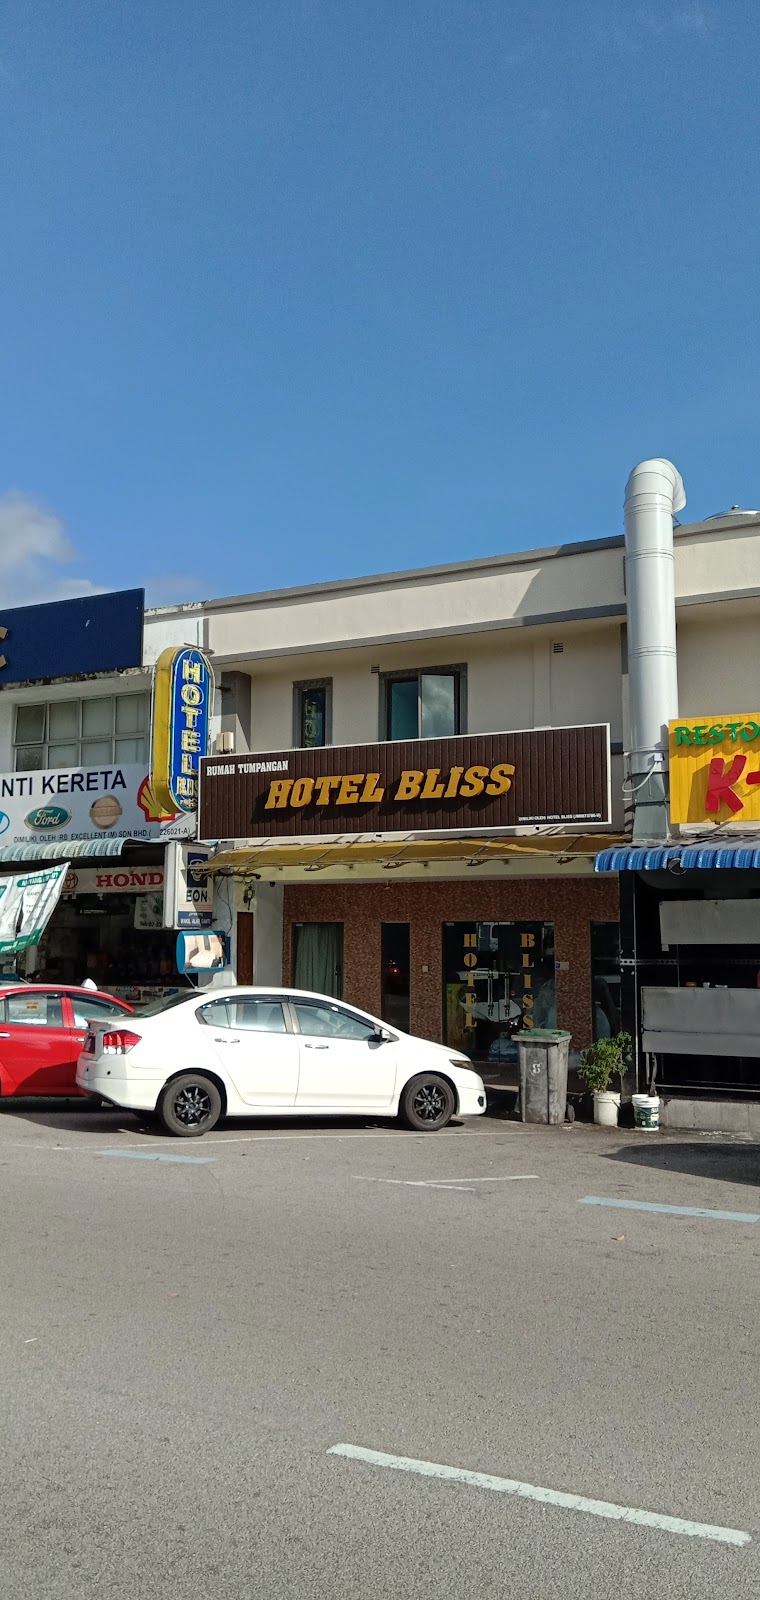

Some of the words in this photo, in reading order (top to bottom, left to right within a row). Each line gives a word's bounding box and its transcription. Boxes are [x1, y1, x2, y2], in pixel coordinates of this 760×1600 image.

[181, 659, 204, 777] HOTEL
[674, 721, 760, 746] RESTO
[206, 764, 235, 776] RUMAH
[238, 760, 289, 774] TUMPANGAN
[2, 777, 33, 797] NTI
[42, 770, 127, 794] KERETA
[264, 773, 385, 810] HOTEL
[394, 763, 516, 801] BLISS
[34, 809, 61, 826] Ford
[40, 834, 56, 842] OLEH
[71, 831, 106, 841] EXCELLENT
[108, 830, 118, 839] (M)
[119, 829, 132, 838] SDN
[186, 889, 208, 902] EON
[463, 933, 478, 1028] HOTEL
[519, 933, 536, 1030] BLISS
